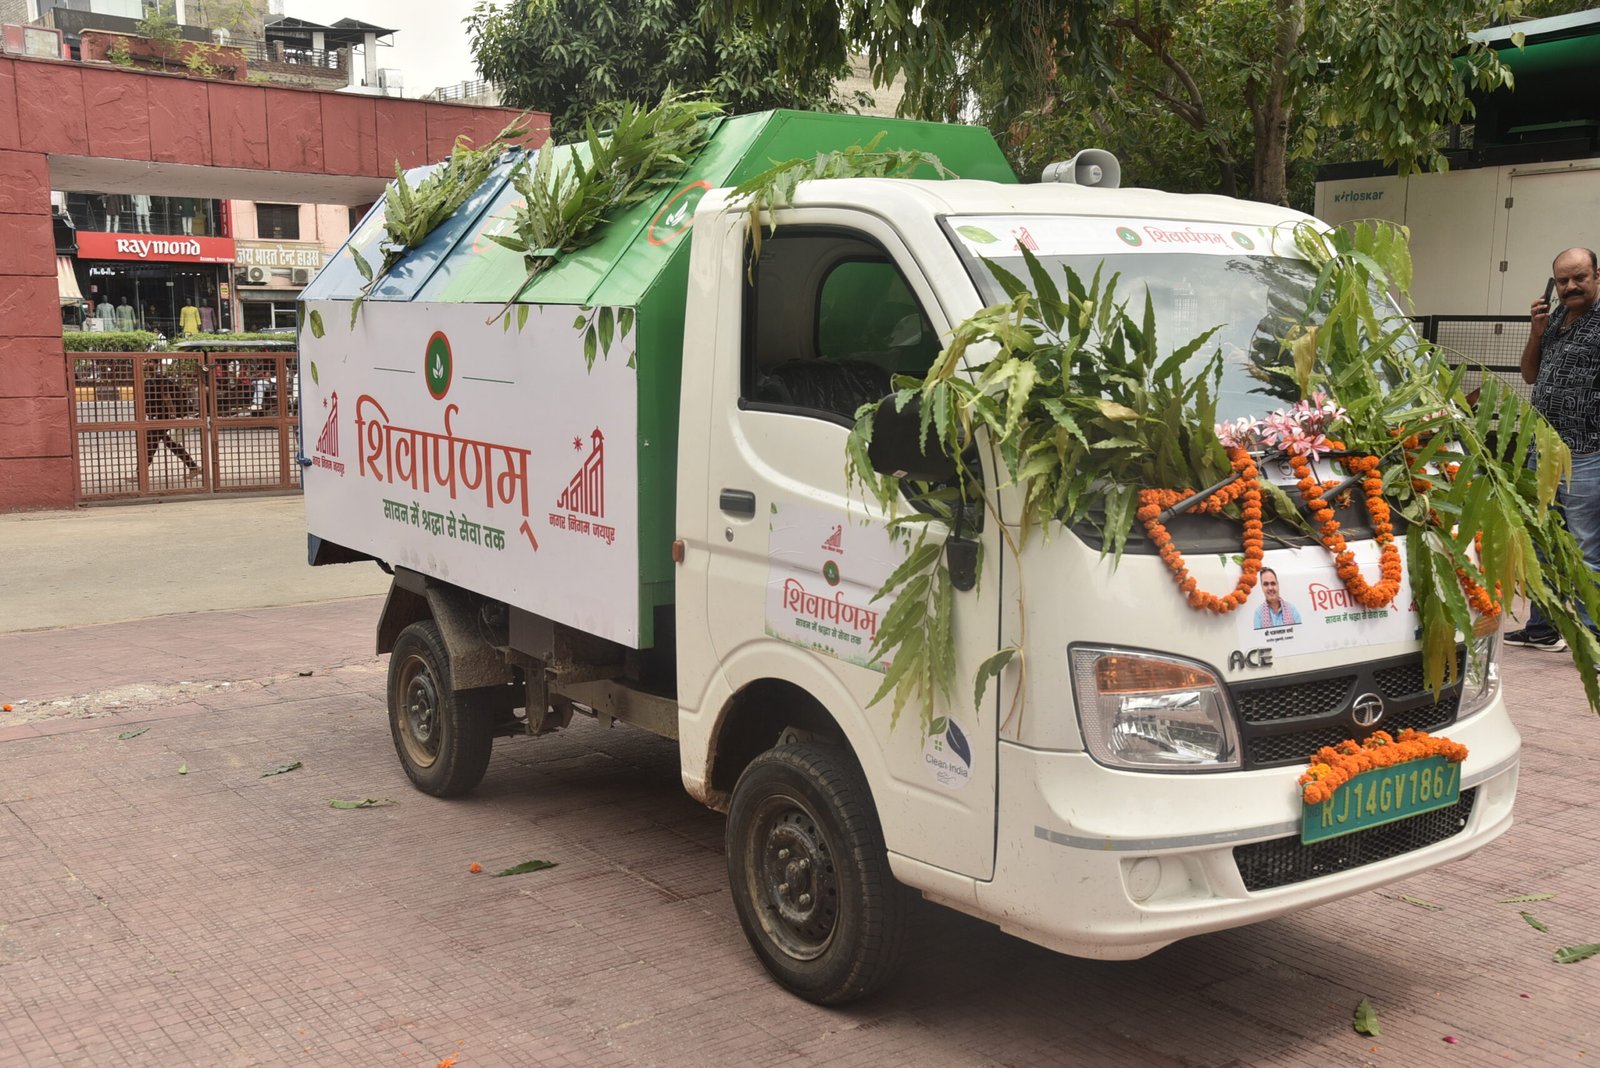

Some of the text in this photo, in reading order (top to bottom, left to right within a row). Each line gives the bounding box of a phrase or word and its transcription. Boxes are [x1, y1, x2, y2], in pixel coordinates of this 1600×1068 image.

[116, 239, 200, 257] Raymond
[1143, 226, 1234, 250] शिवार्पणम्
[236, 248, 254, 264] जय
[255, 248, 277, 266] भारत
[355, 394, 539, 552] शिवार्पणम्
[383, 499, 505, 551] सावन में श्रद्धा से सेवा तक
[549, 513, 615, 545] नगर निगम जयपुर
[1228, 648, 1273, 671] ACE
[925, 753, 968, 778] Clean India
[1322, 763, 1458, 828] RJ14GV1867
